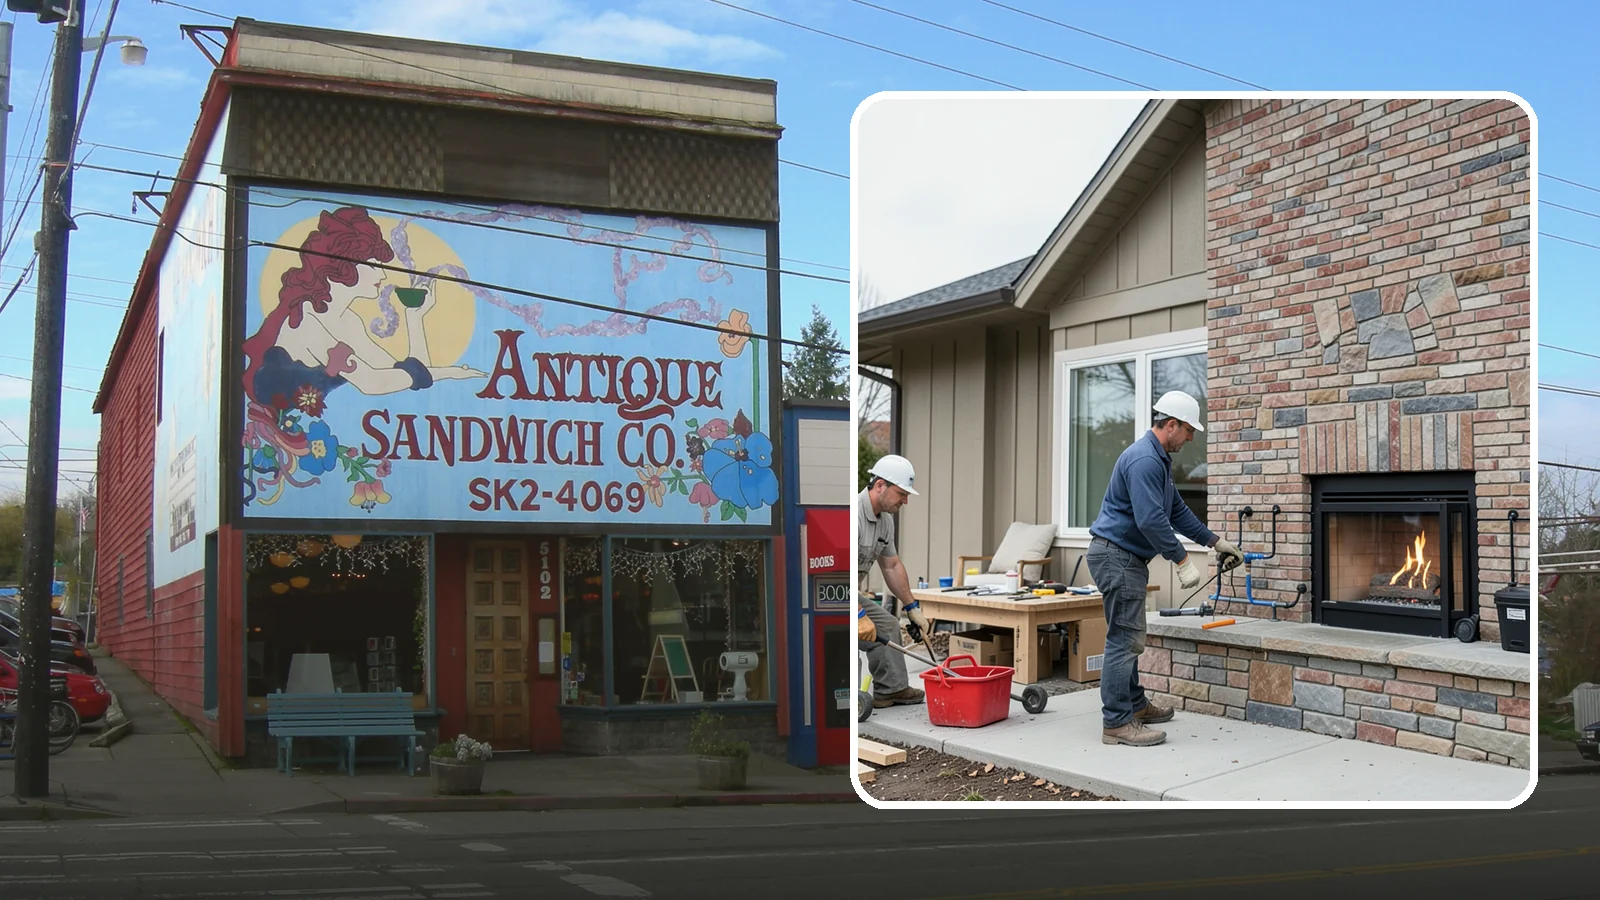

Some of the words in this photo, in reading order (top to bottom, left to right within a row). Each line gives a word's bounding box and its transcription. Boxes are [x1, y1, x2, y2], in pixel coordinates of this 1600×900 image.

[475, 329, 723, 420] ANTIQUE
[362, 409, 604, 467] SANDWICH
[616, 421, 685, 468] CO.
[468, 477, 646, 513] SK2-4069
[539, 541, 552, 600] 5102
[809, 554, 835, 569] BOOKS
